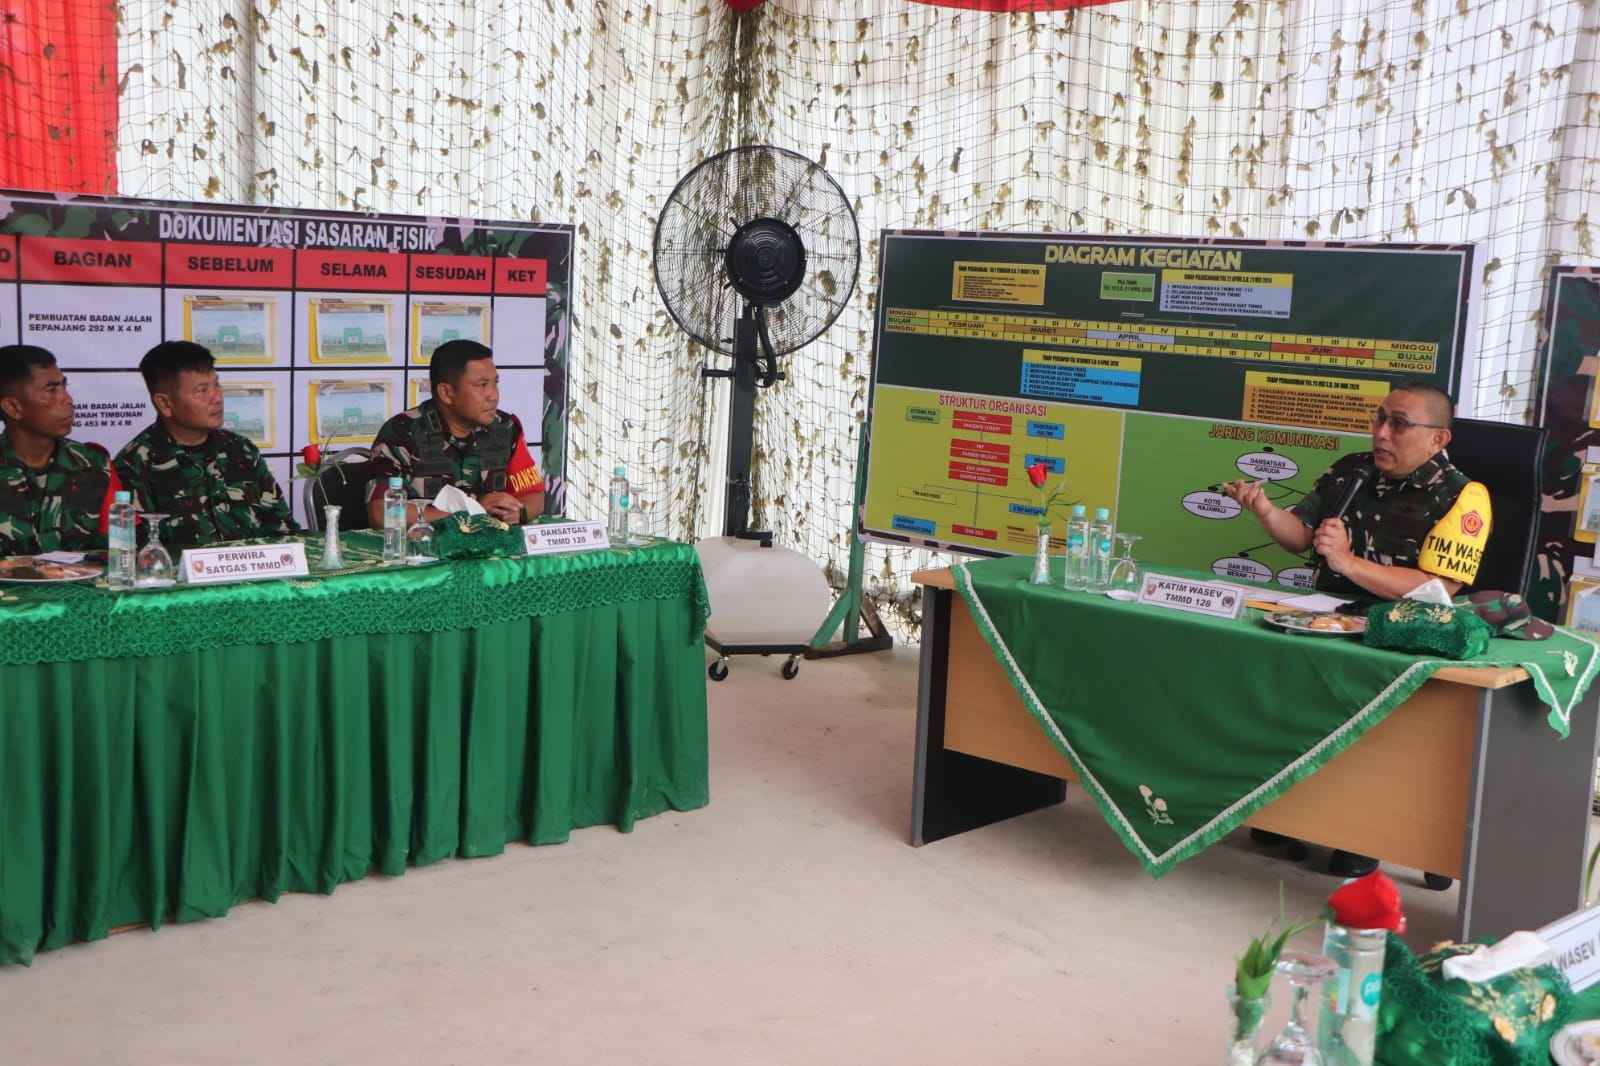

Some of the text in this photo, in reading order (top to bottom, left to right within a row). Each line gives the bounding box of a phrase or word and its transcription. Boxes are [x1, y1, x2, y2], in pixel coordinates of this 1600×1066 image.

[159, 213, 436, 250] DOKUMENTASI SASARAN FISIK
[0, 247, 11, 262] O
[54, 251, 132, 268] BAGIAN
[1044, 244, 1242, 270] DIAGRAM KEGIATAN
[188, 256, 274, 272] SEBELUM
[321, 262, 387, 278] SELAMA
[416, 266, 486, 281] SESUDAH
[508, 270, 536, 282] KET
[29, 313, 152, 323] PEMBUATAN BADAN JALAN
[29, 323, 86, 332] SEPANJANG
[88, 324, 104, 332] 292
[1391, 342, 1434, 352] MINGGU
[1398, 353, 1433, 361] BULAN
[1389, 361, 1432, 371] MINGGU
[91, 402, 118, 410] BADAN
[120, 402, 146, 410] JALAN
[938, 394, 1047, 416] STRUKTUR ORGANISASI
[101, 410, 142, 418] TIMBUNAN
[1210, 424, 1340, 450] JARING KOMUNIKASI
[509, 465, 542, 492] DANSA
[541, 526, 588, 537] DANSATGAS
[547, 536, 570, 546] TMMD
[217, 550, 265, 561] PERWIRA
[1426, 535, 1484, 562] TIM WAS
[206, 561, 281, 575] SATGAS TMMD
[1158, 581, 1223, 598] KATIM WASEV
[1165, 593, 1192, 605] TMMD
